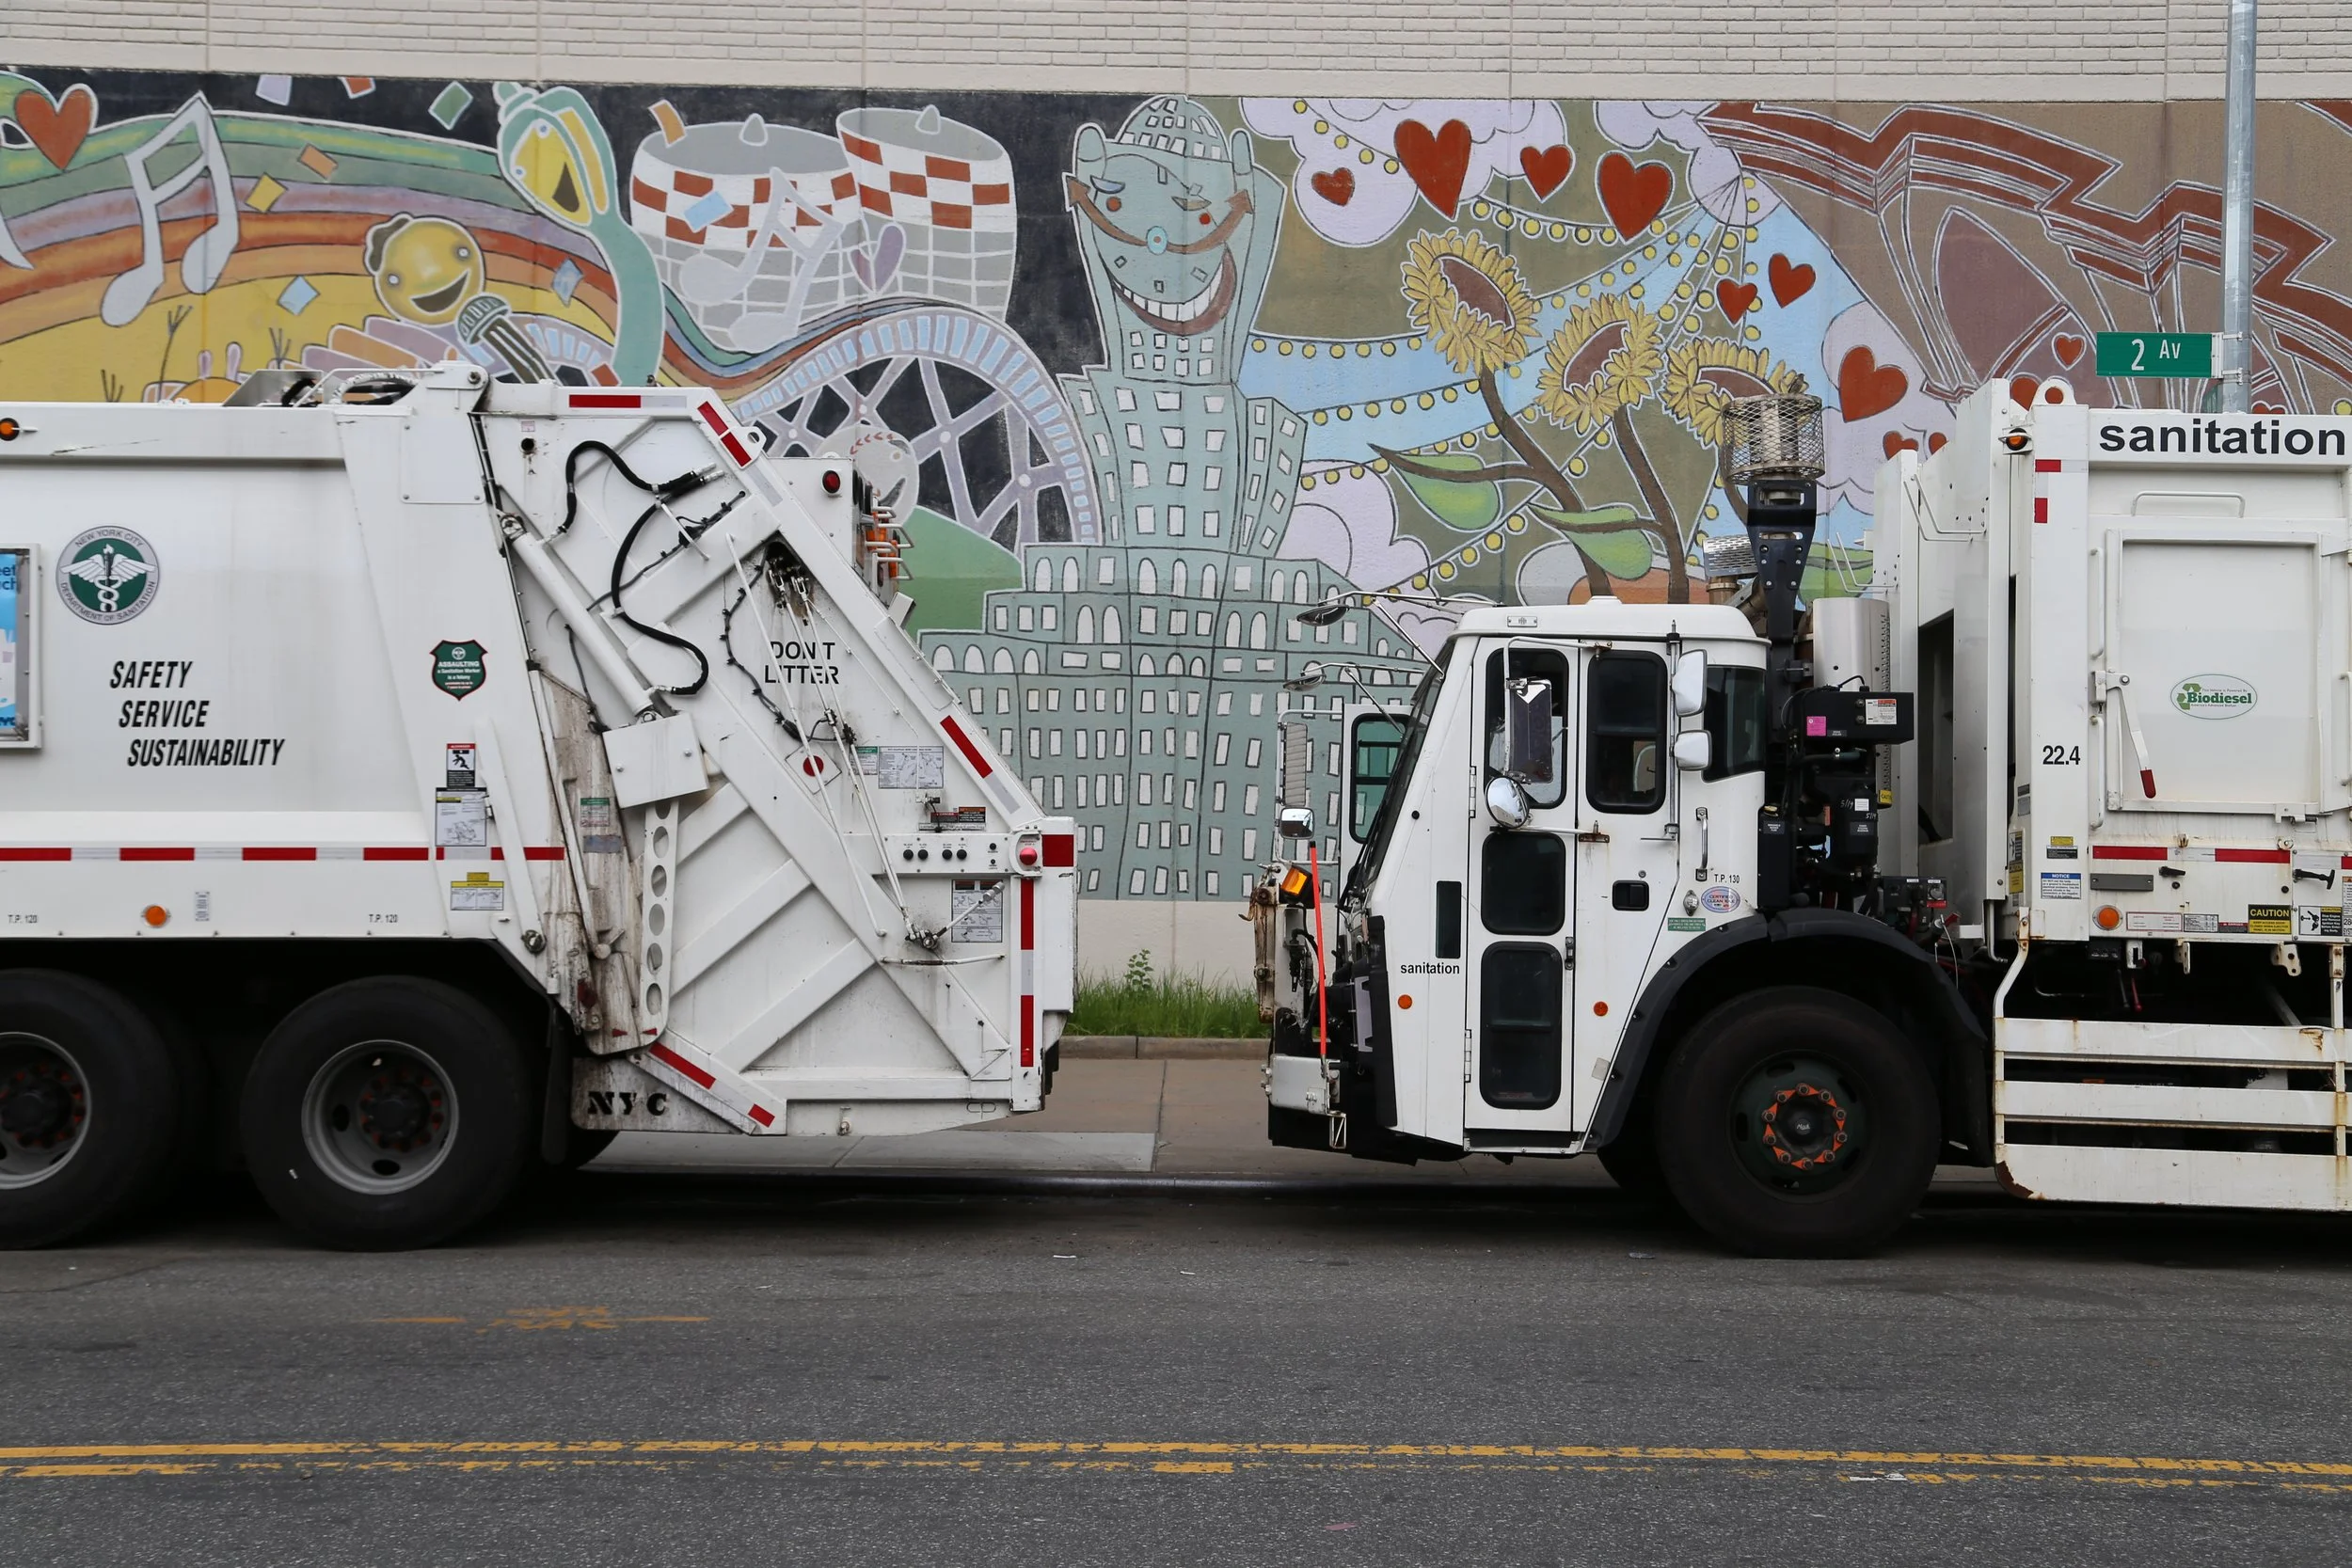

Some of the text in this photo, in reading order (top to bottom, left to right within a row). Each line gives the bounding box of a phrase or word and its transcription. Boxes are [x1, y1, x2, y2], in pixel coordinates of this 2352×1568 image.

[2131, 339, 2145, 371] 2
[2099, 419, 2345, 455] sanitation
[75, 529, 144, 547] NEW YORK CITY
[60, 582, 103, 621] DEPARTMENT
[117, 581, 155, 619] SANITATION
[770, 641, 835, 659] DONT
[110, 660, 193, 689] SAFETY
[765, 665, 839, 684] LTTER
[2187, 691, 2252, 704] Biodiesel
[119, 700, 210, 728] SERVICE
[127, 738, 285, 767] SUSTAINABILITY
[2042, 745, 2081, 765] 22.4
[1714, 874, 1740, 883] T.P. 130
[2249, 909, 2290, 917] CAUTION
[1400, 961, 1460, 974] sanitation
